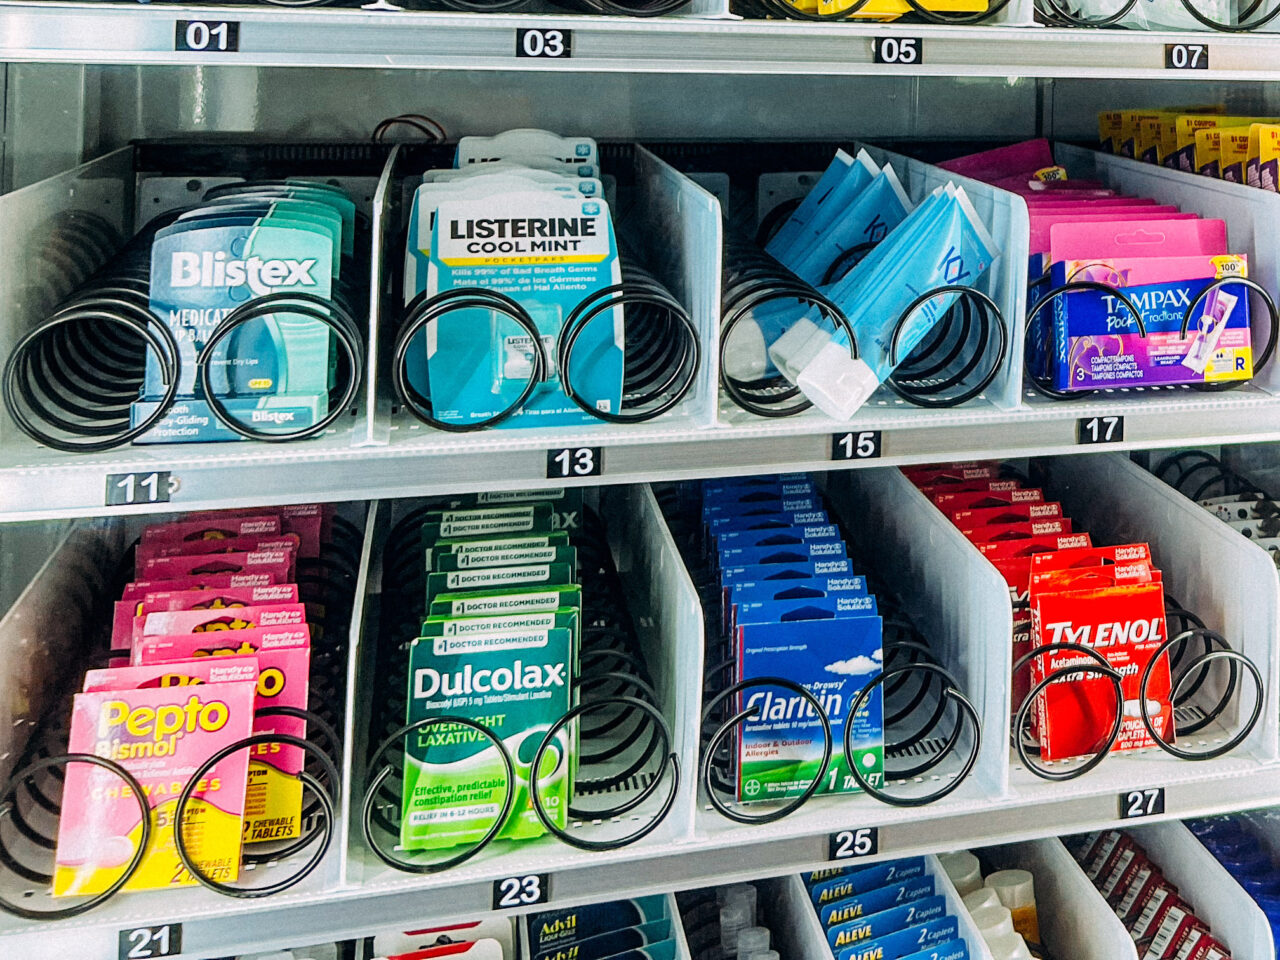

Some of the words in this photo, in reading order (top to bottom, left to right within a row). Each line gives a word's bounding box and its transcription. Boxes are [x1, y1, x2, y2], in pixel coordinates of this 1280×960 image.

[186, 21, 229, 50] 01
[523, 29, 564, 57] 03
[881, 38, 917, 63] 05
[1172, 45, 1204, 68] 07
[1193, 119, 1217, 127] COUPON
[450, 217, 597, 239] LISTERINE
[466, 241, 526, 253] COOL
[530, 240, 581, 252] MINT
[170, 250, 318, 296] Blistex
[452, 268, 472, 276] Kills
[500, 267, 511, 275] of
[534, 266, 565, 274] Breath
[532, 276, 547, 284] los
[1101, 288, 1192, 314] TAMPAX
[1150, 312, 1184, 322] radiant
[232, 358, 244, 366] Dry
[245, 358, 259, 366] Lips
[1235, 358, 1245, 370] R
[1076, 368, 1085, 381] 3
[251, 411, 294, 424] Blistex
[152, 427, 199, 437] Protection
[1086, 417, 1119, 441] 17
[839, 432, 875, 458] 15
[554, 448, 594, 475] 13
[117, 473, 159, 503] 11
[1115, 547, 1138, 556] Handy
[1115, 553, 1146, 561] Solutions
[451, 575, 460, 586] #1
[461, 575, 491, 583] DOCTOR
[492, 570, 546, 580] RECOMMENDED
[827, 578, 852, 587] Handy
[827, 583, 861, 591] Solutions
[456, 602, 465, 614] #1
[466, 602, 498, 611] DOCTOR
[499, 597, 556, 608] RECOMMENDED
[837, 597, 863, 605] Handy
[837, 602, 873, 611] Solutions
[438, 640, 447, 652] #1
[449, 640, 483, 649] DOCTOR
[484, 635, 545, 646] RECOMMENDED
[1046, 617, 1163, 655] TYLENOL
[414, 660, 566, 699] Dulcolax
[746, 690, 843, 722] Claritin
[99, 695, 229, 742] Pepto
[1153, 717, 1164, 727] OF
[418, 731, 487, 748] LAXATIVE
[745, 742, 771, 750] Indoor
[781, 739, 813, 747] Outdoor
[1118, 730, 1145, 742] CAPLETS
[95, 735, 178, 760] Bismol
[745, 749, 779, 757] Allergies
[829, 767, 838, 790] 1
[415, 784, 456, 796] Effective,
[457, 779, 506, 793] predictable
[414, 793, 469, 807] constipation
[470, 790, 493, 800] relief
[544, 796, 560, 807] 10
[1127, 790, 1160, 816] 27
[156, 811, 169, 828] 5
[253, 816, 294, 828] CHEWABLE
[413, 813, 438, 821] RELIEF
[468, 807, 495, 815] HOURS
[251, 827, 294, 839] TABLETS
[835, 829, 873, 857] 25
[499, 876, 541, 906] 23
[819, 882, 853, 903] ALEVE
[828, 903, 863, 924] ALEVE
[905, 885, 931, 898] Caplets
[541, 914, 577, 936] Advil
[835, 924, 872, 947] ALEVE
[905, 907, 916, 922] 2
[915, 905, 942, 918] Caplets
[128, 925, 170, 959] 21
[918, 928, 928, 944] 2
[927, 926, 955, 940] Caplets
